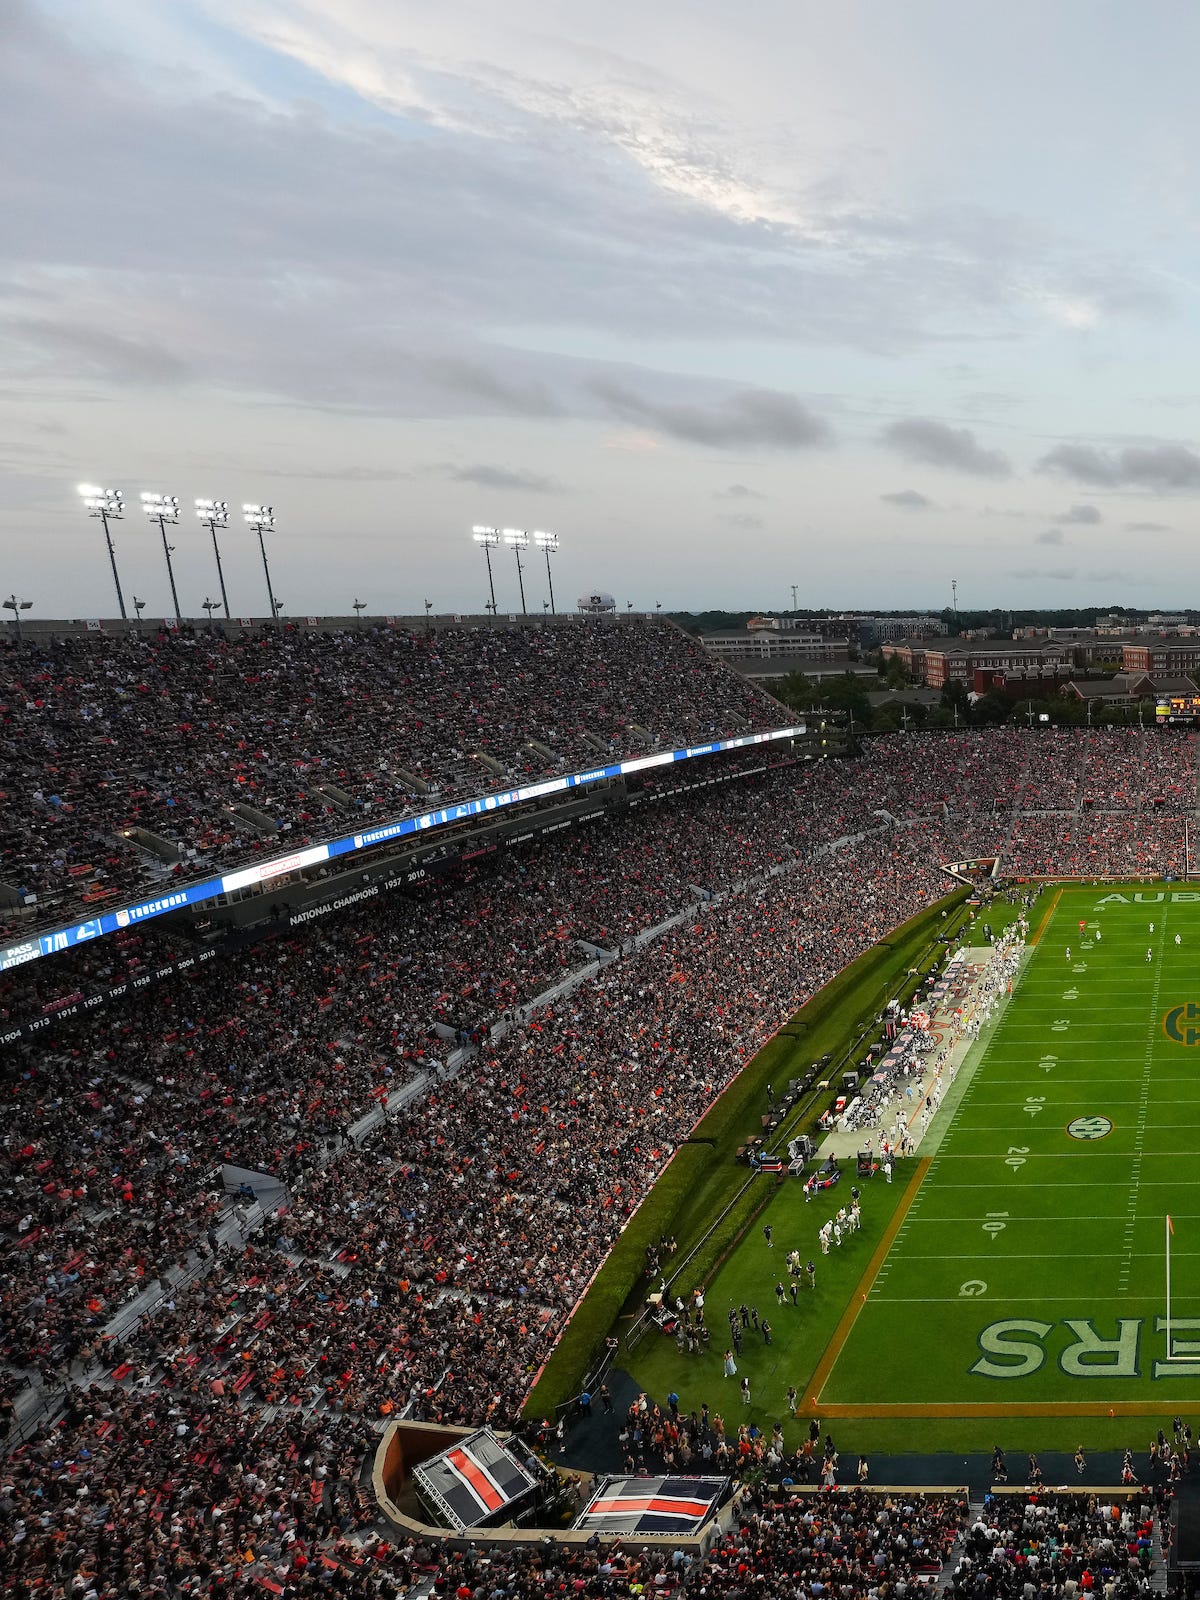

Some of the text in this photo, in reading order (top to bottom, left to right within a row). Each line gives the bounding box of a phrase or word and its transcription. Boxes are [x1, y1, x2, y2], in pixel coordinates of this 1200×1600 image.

[129, 893, 188, 919] TRUCKWORX
[289, 869, 425, 926] NATIONAL CHAMPIONS 1957 2010
[7, 943, 33, 958] PASS
[0, 949, 216, 1044] 1904 1913 1914 1932 1957 1958 1993 2004 2010
[1051, 1019, 1070, 1031] 50
[1038, 1055, 1058, 1068] 40
[1023, 1096, 1046, 1113] 30
[1004, 1146, 1030, 1166] 20
[982, 1211, 1009, 1231] 10
[959, 1279, 988, 1297] G
